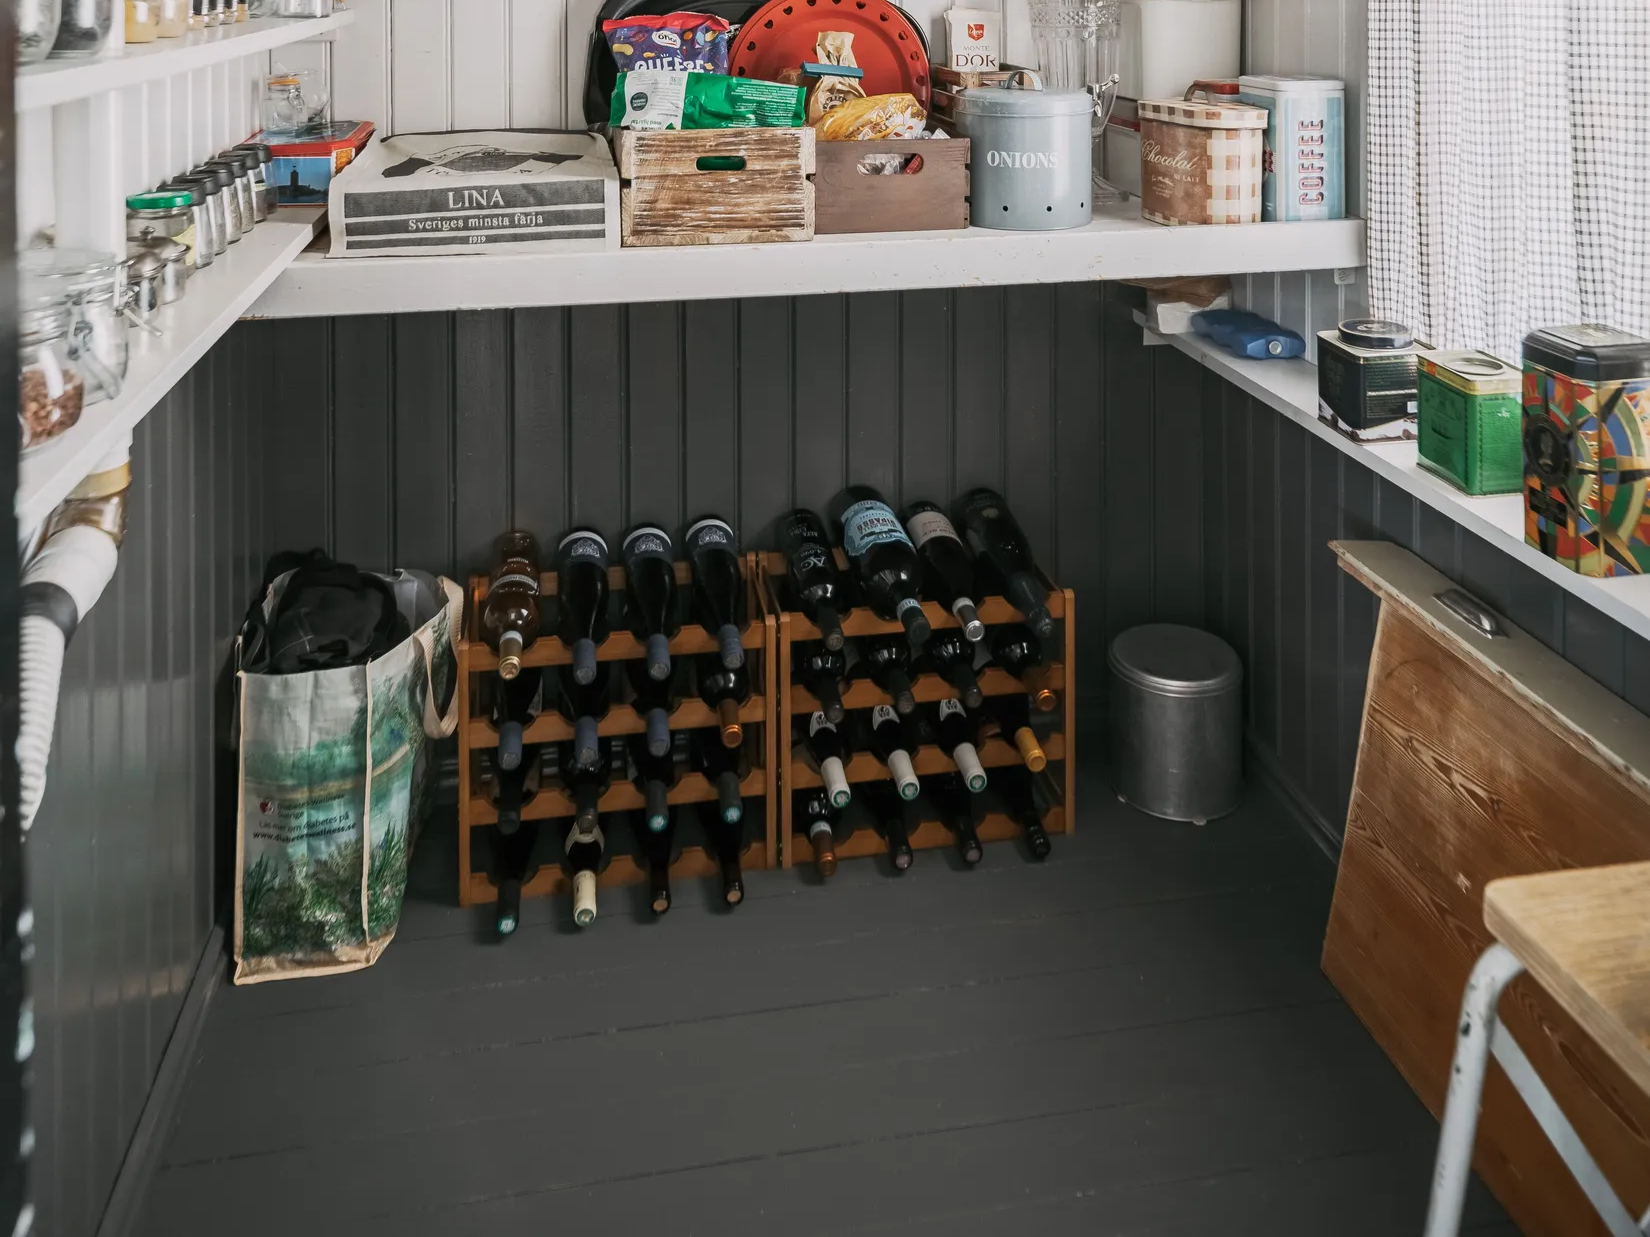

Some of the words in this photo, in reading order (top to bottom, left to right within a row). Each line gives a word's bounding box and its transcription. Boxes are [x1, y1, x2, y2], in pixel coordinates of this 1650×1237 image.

[955, 53, 997, 68] D'OR
[986, 150, 1059, 169] ONIONS
[1141, 140, 1198, 171] Chocolat
[1297, 118, 1324, 205] COFFEE
[447, 188, 505, 209] LINA
[408, 218, 464, 232] Sveriges
[468, 215, 510, 228] minsta
[514, 212, 544, 227] färja
[468, 235, 487, 244] 1919
[303, 816, 338, 829] diabetes
[339, 811, 350, 824] på
